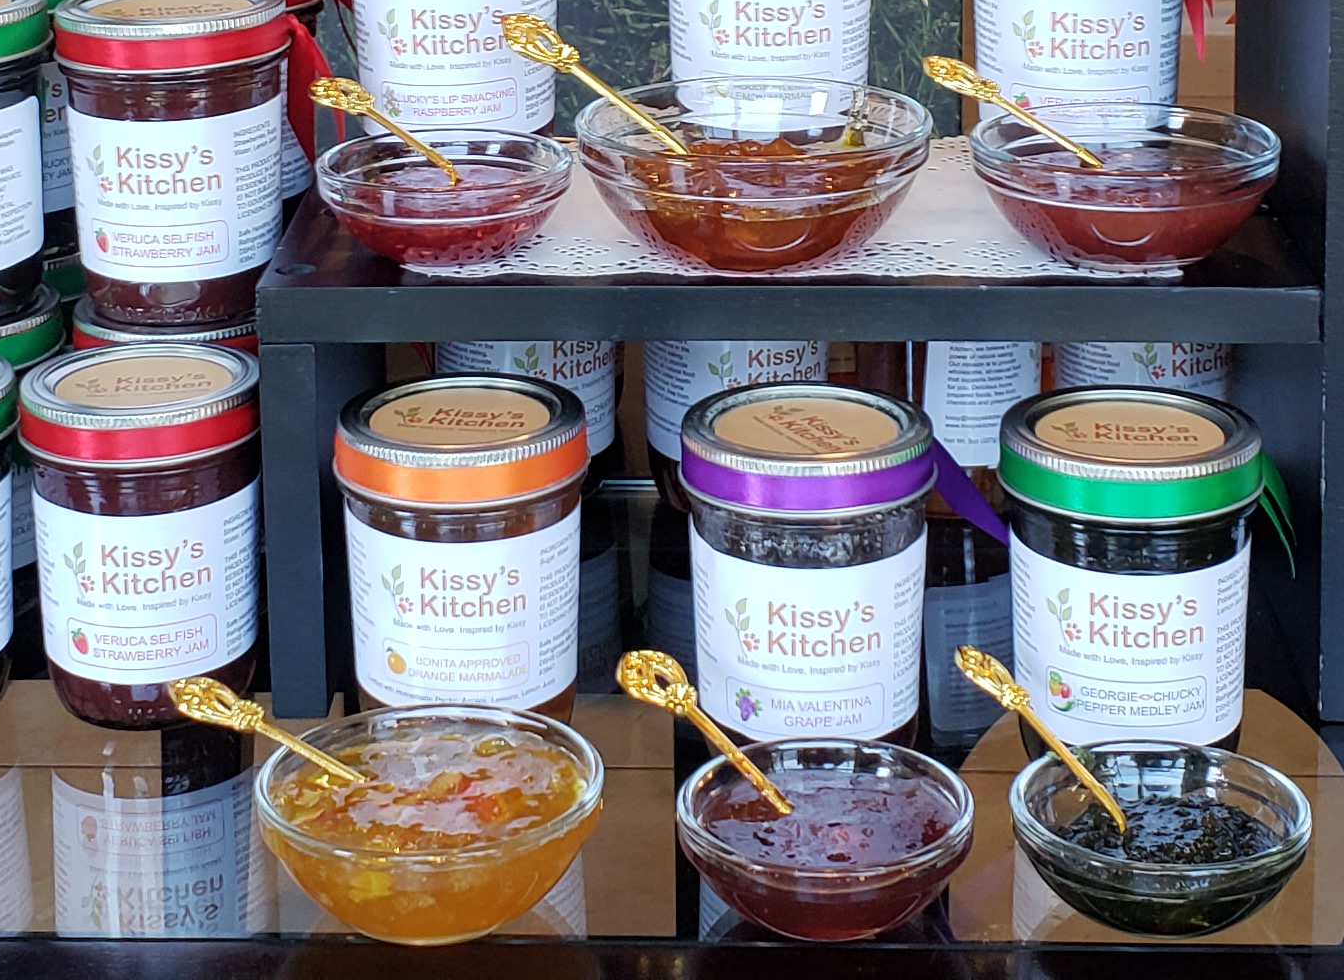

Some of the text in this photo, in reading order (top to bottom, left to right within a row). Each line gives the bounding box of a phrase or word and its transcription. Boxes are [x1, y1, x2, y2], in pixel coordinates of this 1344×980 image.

[411, 6, 503, 32] Kissy's
[735, 0, 826, 27] Kissy's
[1051, 11, 1146, 39] Kissy's
[735, 26, 831, 47] Kitchen
[1050, 37, 1150, 60] Kitchen
[398, 88, 515, 104] LUCKY'S LIP SMACKING
[413, 104, 501, 117] RASPBERRY JAM
[115, 145, 214, 173] Kissy's
[118, 172, 222, 195] Kitchen
[113, 231, 214, 244] VERUCA SELFISH
[112, 244, 221, 259] STRAWBERRY JAM
[748, 340, 818, 368] Kissy's
[114, 381, 212, 393] Kitchen
[116, 372, 206, 384] Kissy's
[427, 416, 526, 428] Kitchen
[434, 407, 524, 420] Kissy's
[1095, 422, 1190, 435] Kissy's
[1095, 432, 1199, 443] Kitchen
[101, 539, 204, 568] Kissy's
[102, 565, 212, 595] Kitchen
[420, 565, 520, 595] Kissy's
[420, 593, 526, 618] Kitchen
[1089, 592, 1198, 626] Kissy's
[768, 601, 874, 633] Kissy's
[94, 626, 204, 647] VERUCA SELFISH
[768, 630, 881, 658] Kitchen
[1089, 621, 1204, 649] Kitchen
[93, 639, 210, 661] STRAWBERRY JAM
[1059, 644, 1081, 659] Made
[1084, 652, 1101, 662] with
[1131, 657, 1167, 667] Inspired
[1169, 656, 1180, 666] by
[1182, 651, 1203, 663] Kissy
[416, 654, 520, 669] BONITA APPROVED
[737, 656, 759, 669] Made
[762, 664, 780, 673] with
[809, 666, 845, 677] Inspired
[848, 664, 858, 675] by
[860, 659, 881, 671] Kissy
[407, 664, 528, 682] ORANGE MARMALADE
[771, 695, 872, 712] MIA VALENTINA
[1080, 686, 1203, 702] GEORGIE CHUCKY
[1077, 699, 1205, 716] PEPPER MEDLEY JAM
[784, 713, 862, 728] GRAPE JAM
